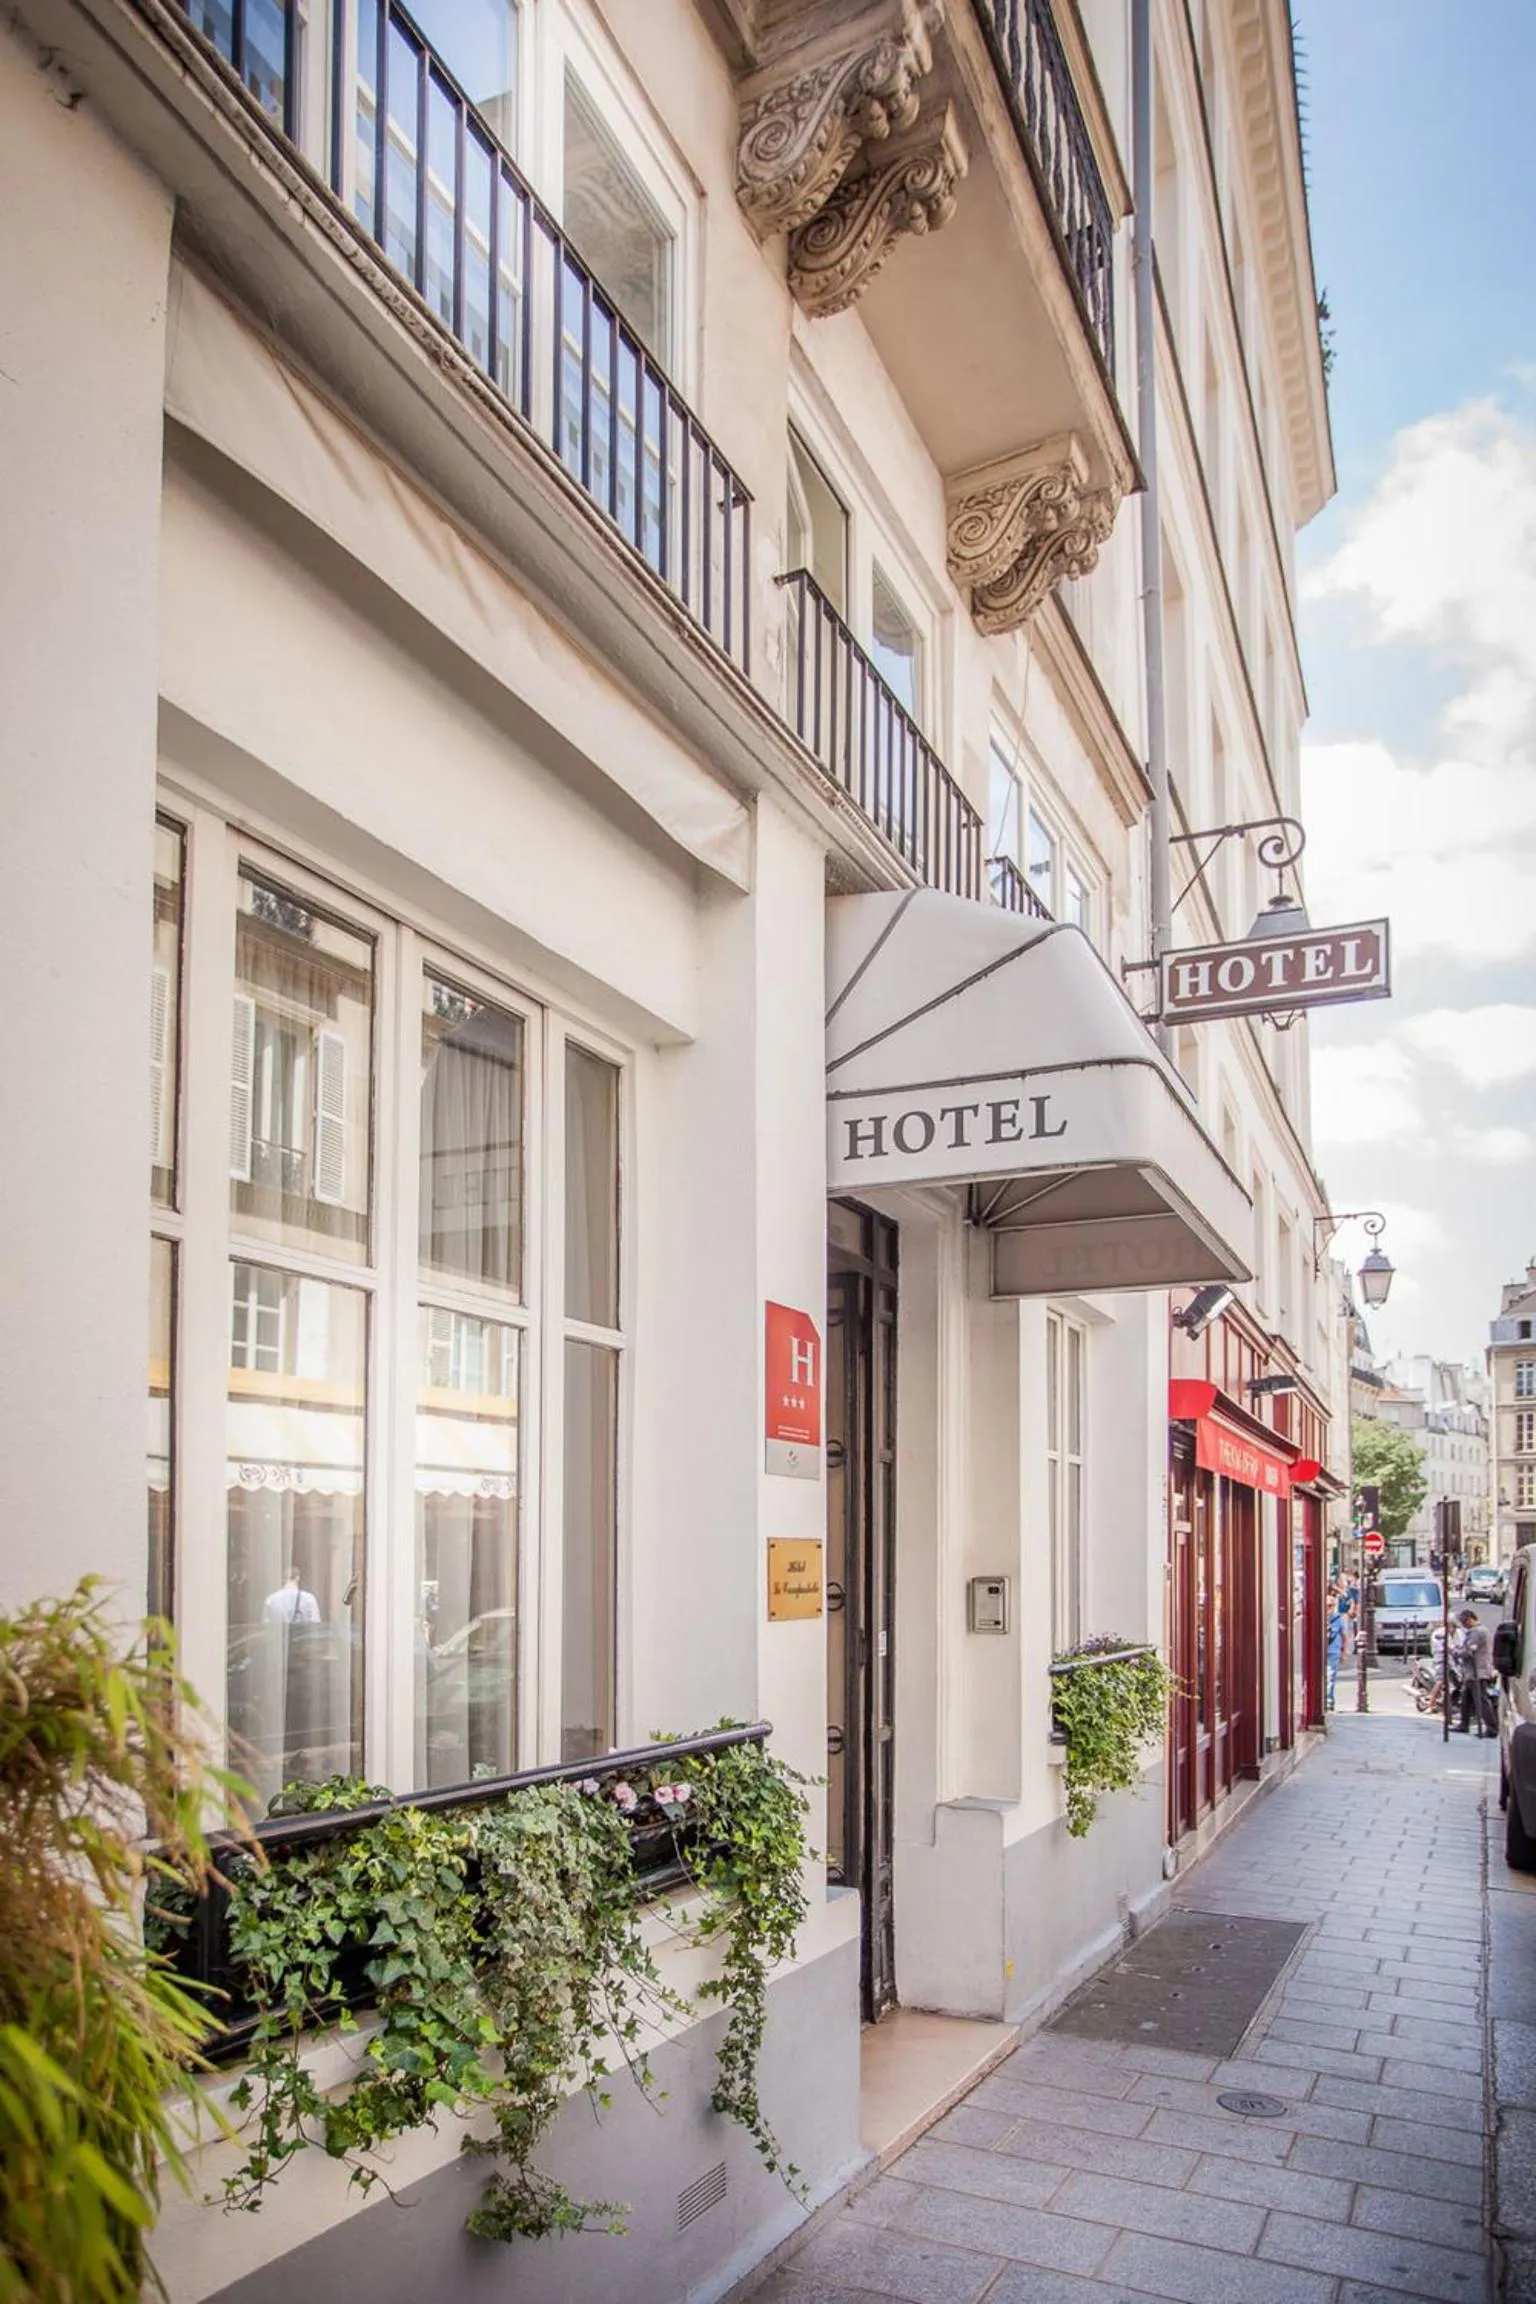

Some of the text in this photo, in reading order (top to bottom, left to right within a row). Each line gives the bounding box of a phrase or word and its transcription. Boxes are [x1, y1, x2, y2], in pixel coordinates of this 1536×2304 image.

[1174, 938, 1374, 1000] HOTEL
[843, 1094, 1069, 1161] HOTEL
[789, 1336, 815, 1388] H
